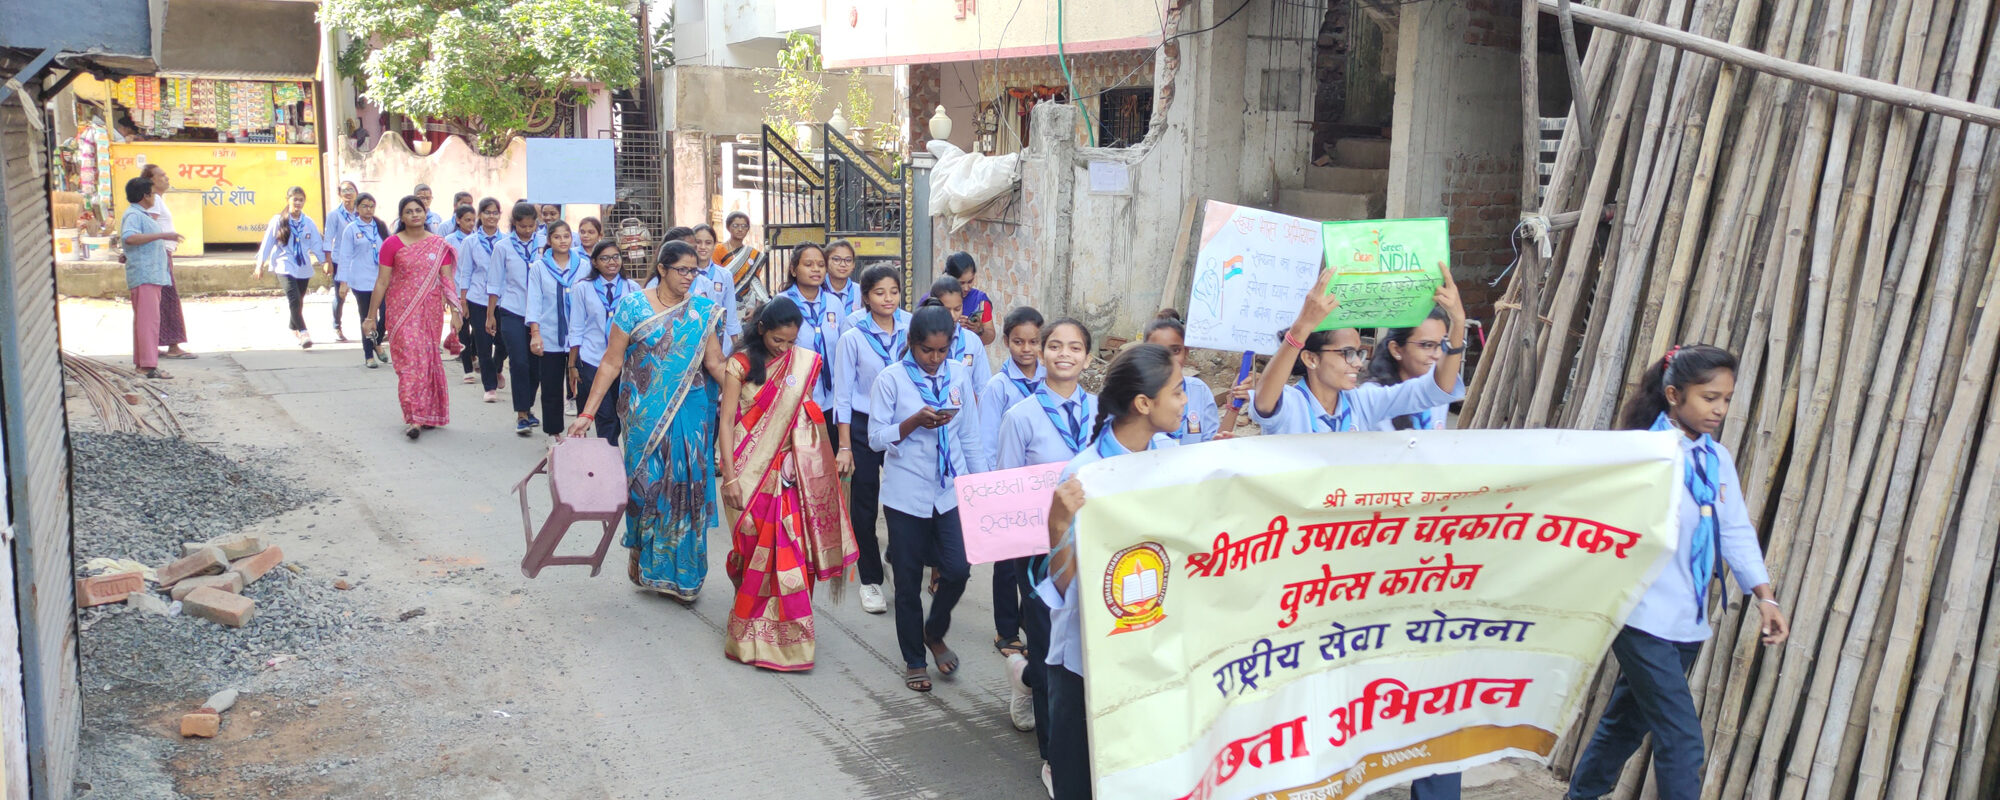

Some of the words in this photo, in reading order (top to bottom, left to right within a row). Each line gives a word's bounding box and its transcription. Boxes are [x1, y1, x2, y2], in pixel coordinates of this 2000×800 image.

[229, 186, 256, 206] शॉप
[1323, 488, 1347, 508] श्री
[1355, 491, 1415, 508] नागपूर
[1184, 515, 1289, 579] श्रीमती
[1292, 511, 1410, 556] उषाबेन
[1413, 502, 1534, 546] चंद्रकांत
[1536, 514, 1643, 559] ठाकर
[1279, 563, 1376, 629] वुमेन्स
[1379, 552, 1485, 597] कॉलेज
[1213, 638, 1306, 697] राष्ट्रीय
[1318, 622, 1391, 660] सेवा
[1405, 610, 1536, 644] योजना
[1328, 677, 1534, 748] अभियान
